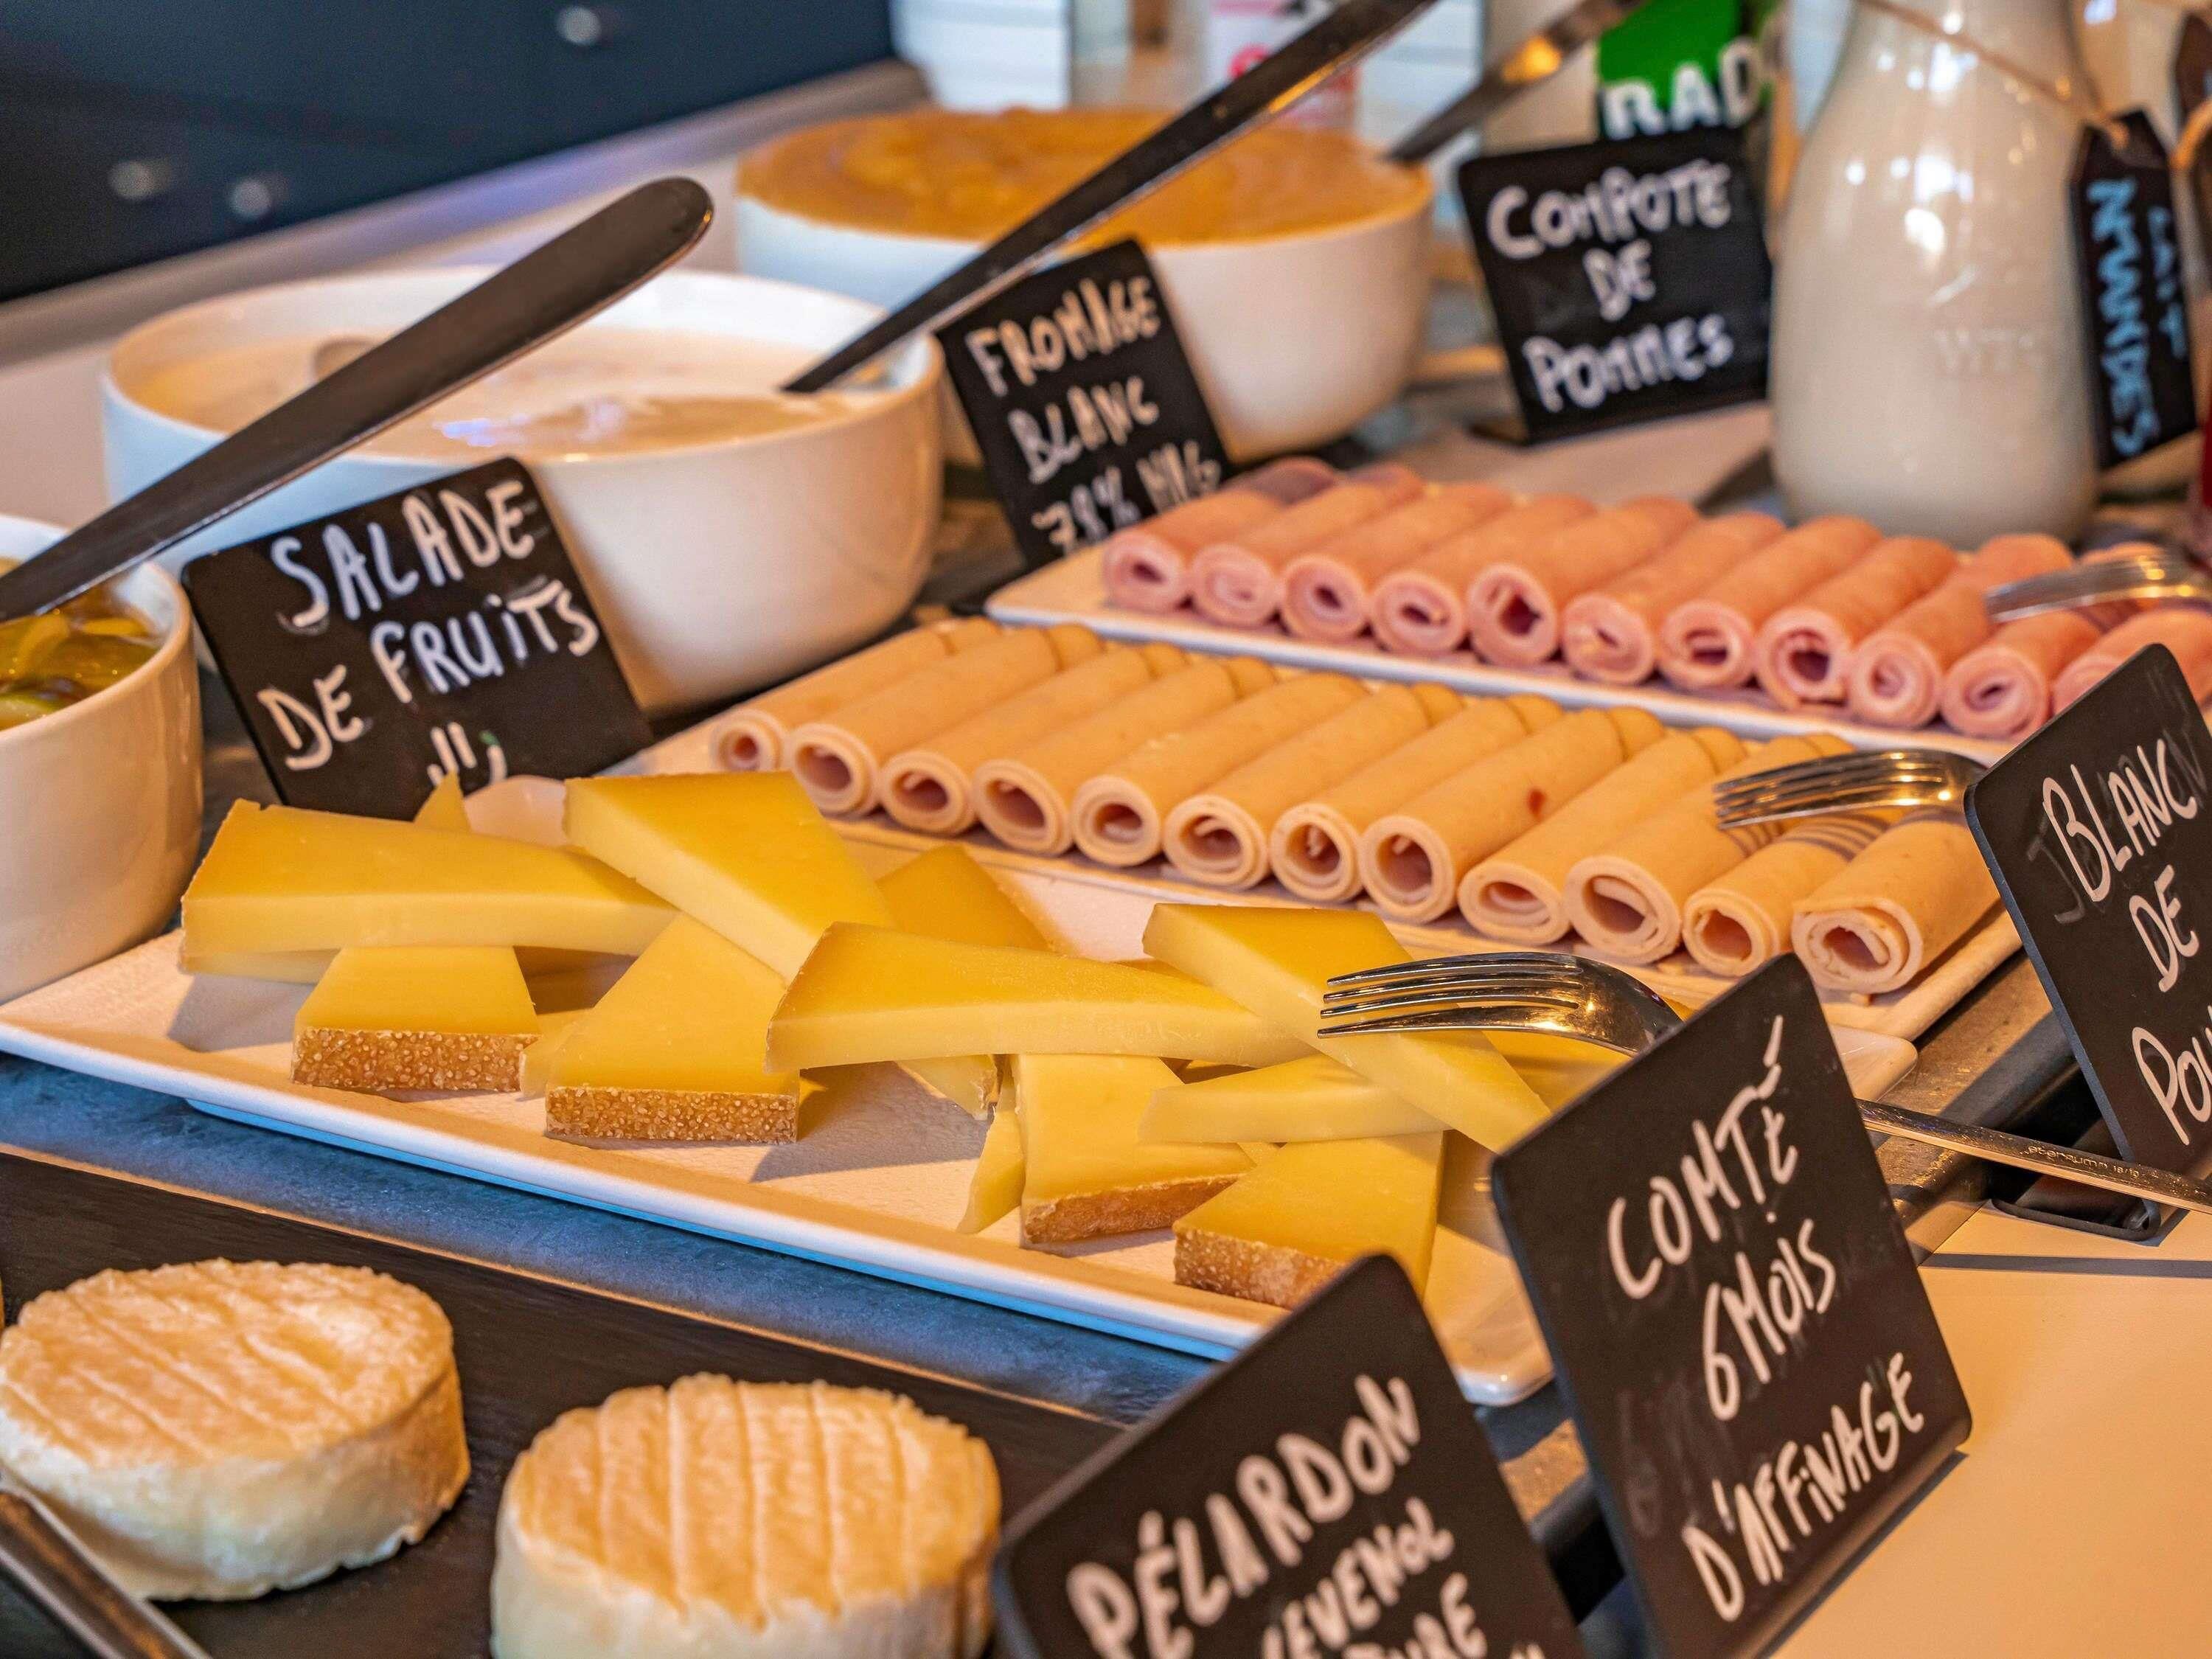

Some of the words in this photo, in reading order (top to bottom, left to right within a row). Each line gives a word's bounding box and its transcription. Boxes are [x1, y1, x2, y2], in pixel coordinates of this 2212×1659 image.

[964, 276, 1162, 397] FROMAGE
[1582, 238, 1656, 321] DE
[1521, 313, 1734, 413] POMMES
[1007, 375, 1161, 485] BLANC
[270, 480, 536, 628] SALADE
[257, 664, 364, 771] DE
[2042, 739, 2198, 903] BLANC
[2128, 863, 2199, 994] DE
[1607, 1014, 1800, 1300] COMTÉ
